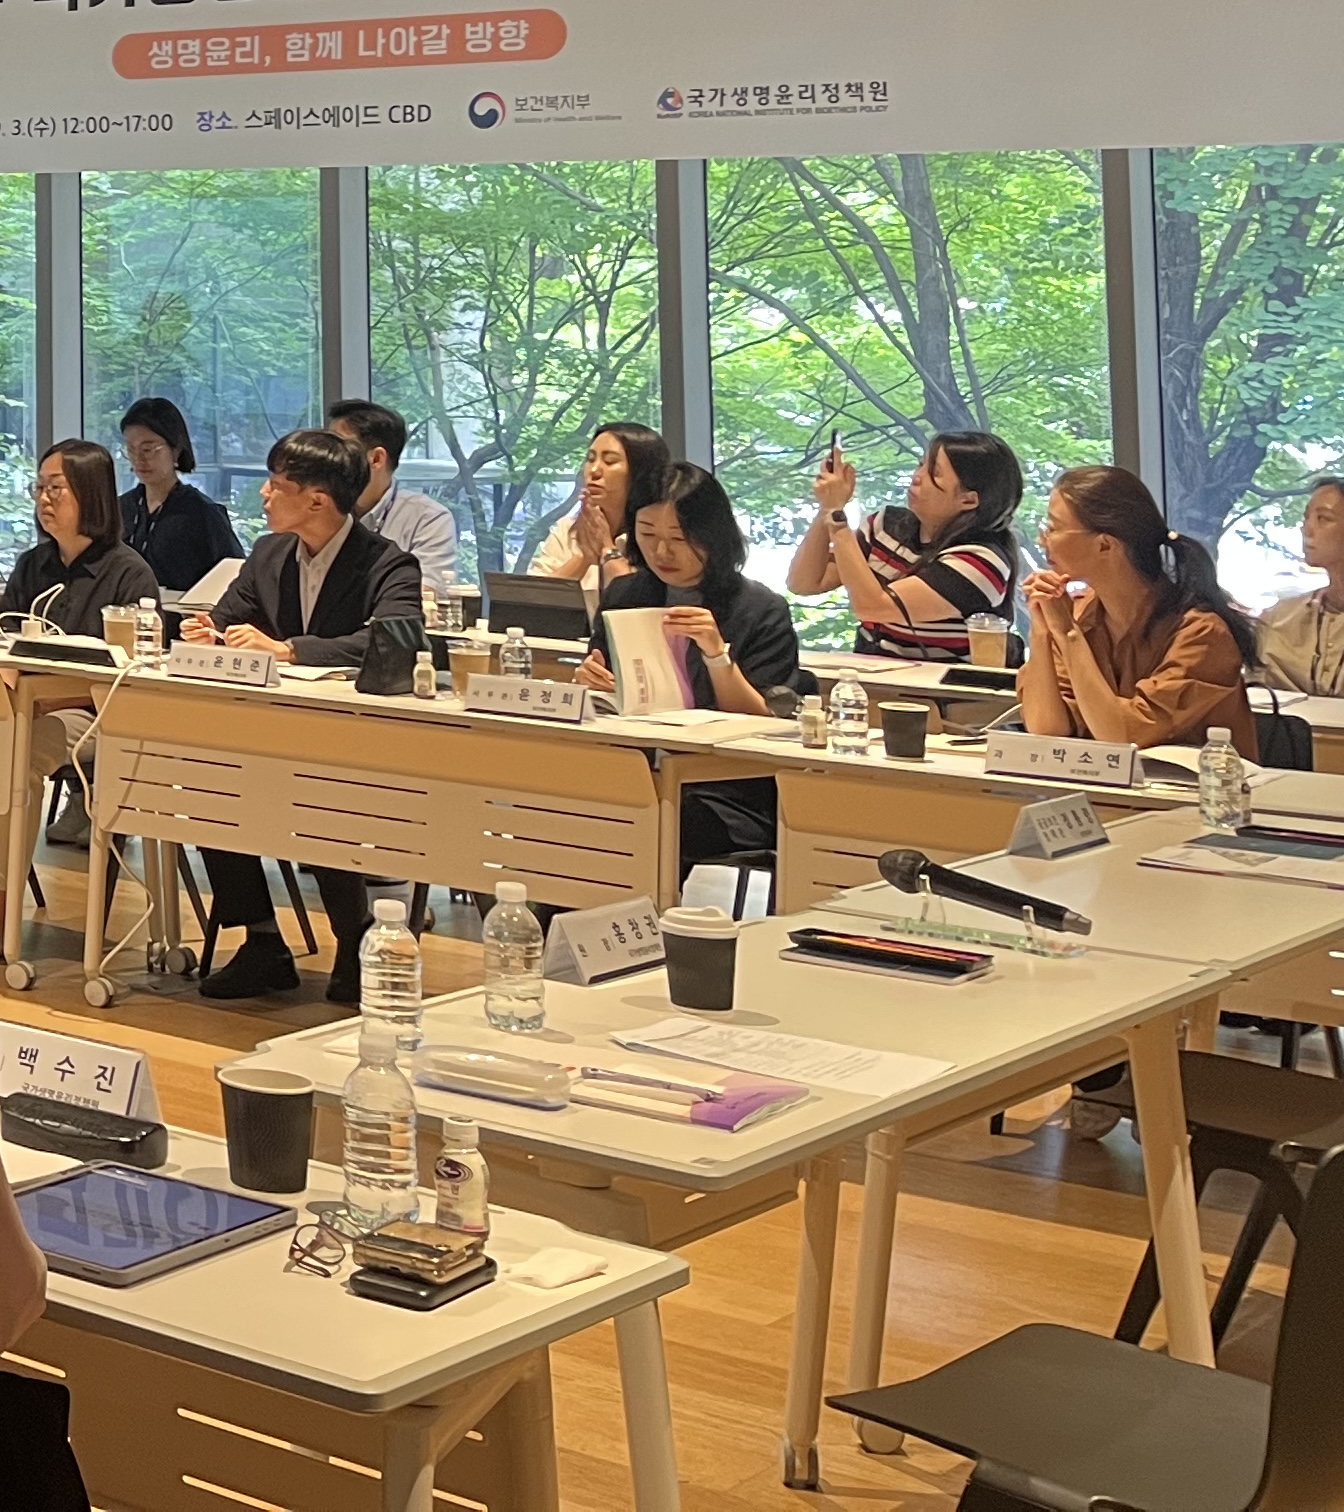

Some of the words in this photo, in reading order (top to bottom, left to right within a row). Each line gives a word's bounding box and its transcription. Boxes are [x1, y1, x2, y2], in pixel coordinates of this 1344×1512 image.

[146, 36, 274, 71] 생명윤리,
[285, 30, 343, 62] 함께
[358, 23, 451, 58] 나아갈
[463, 18, 531, 54] 방향
[514, 93, 591, 112] 보건복지부
[686, 81, 889, 109] 국가생명윤리정책원
[62, 113, 173, 135] 12:00~17:00
[196, 110, 239, 133] 장소.
[244, 104, 382, 130] 스페이스에이드
[388, 104, 432, 124] CBD
[17, 1046, 116, 1094] 백수진
